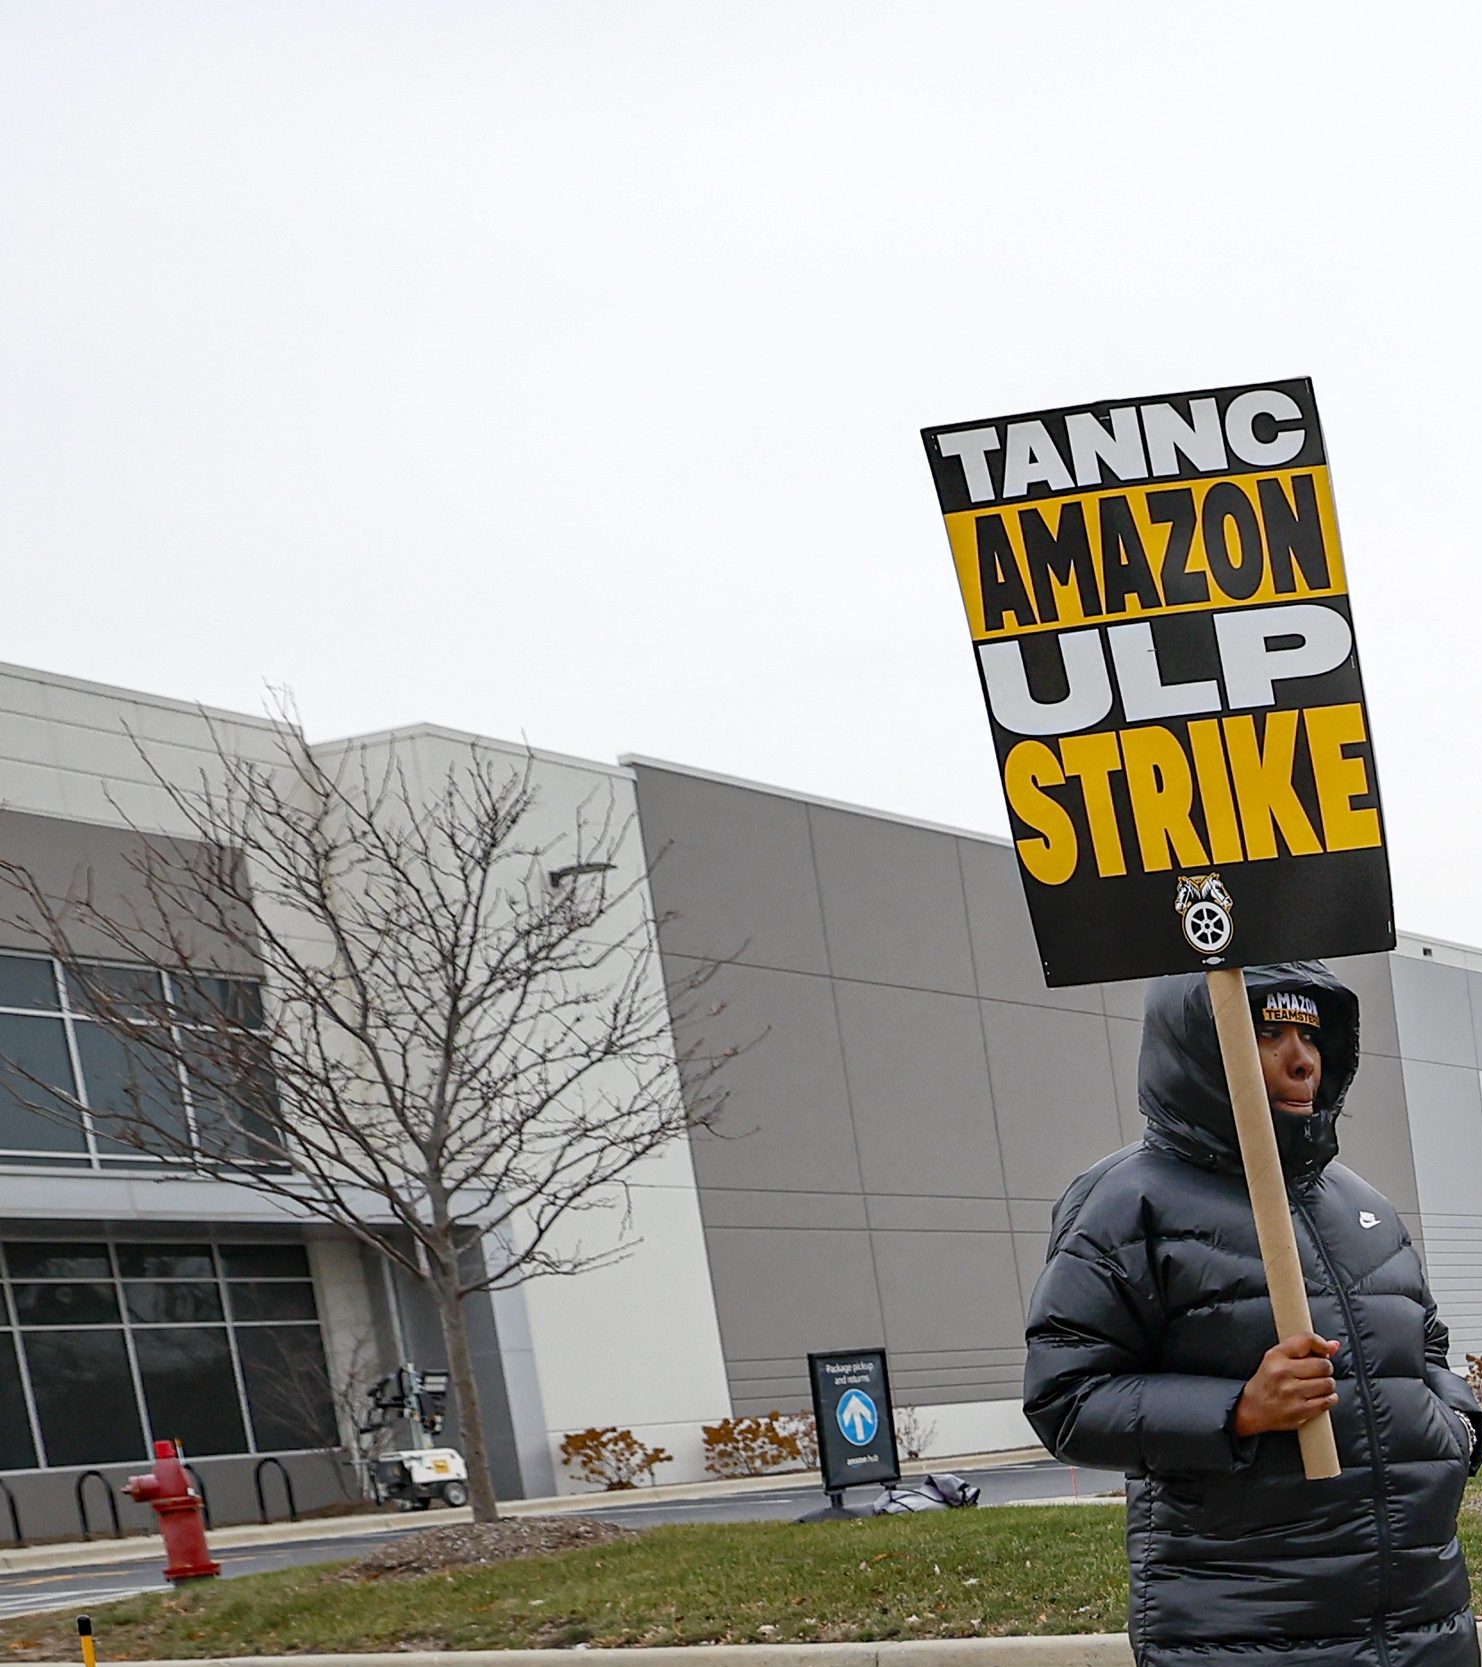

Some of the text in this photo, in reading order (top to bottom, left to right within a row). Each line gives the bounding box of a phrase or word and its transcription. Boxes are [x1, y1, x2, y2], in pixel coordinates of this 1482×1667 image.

[937, 389, 1306, 503] TANNC
[975, 473, 1332, 632] AMAZON
[977, 605, 1353, 736] ULP
[1004, 703, 1382, 886] STRIKE
